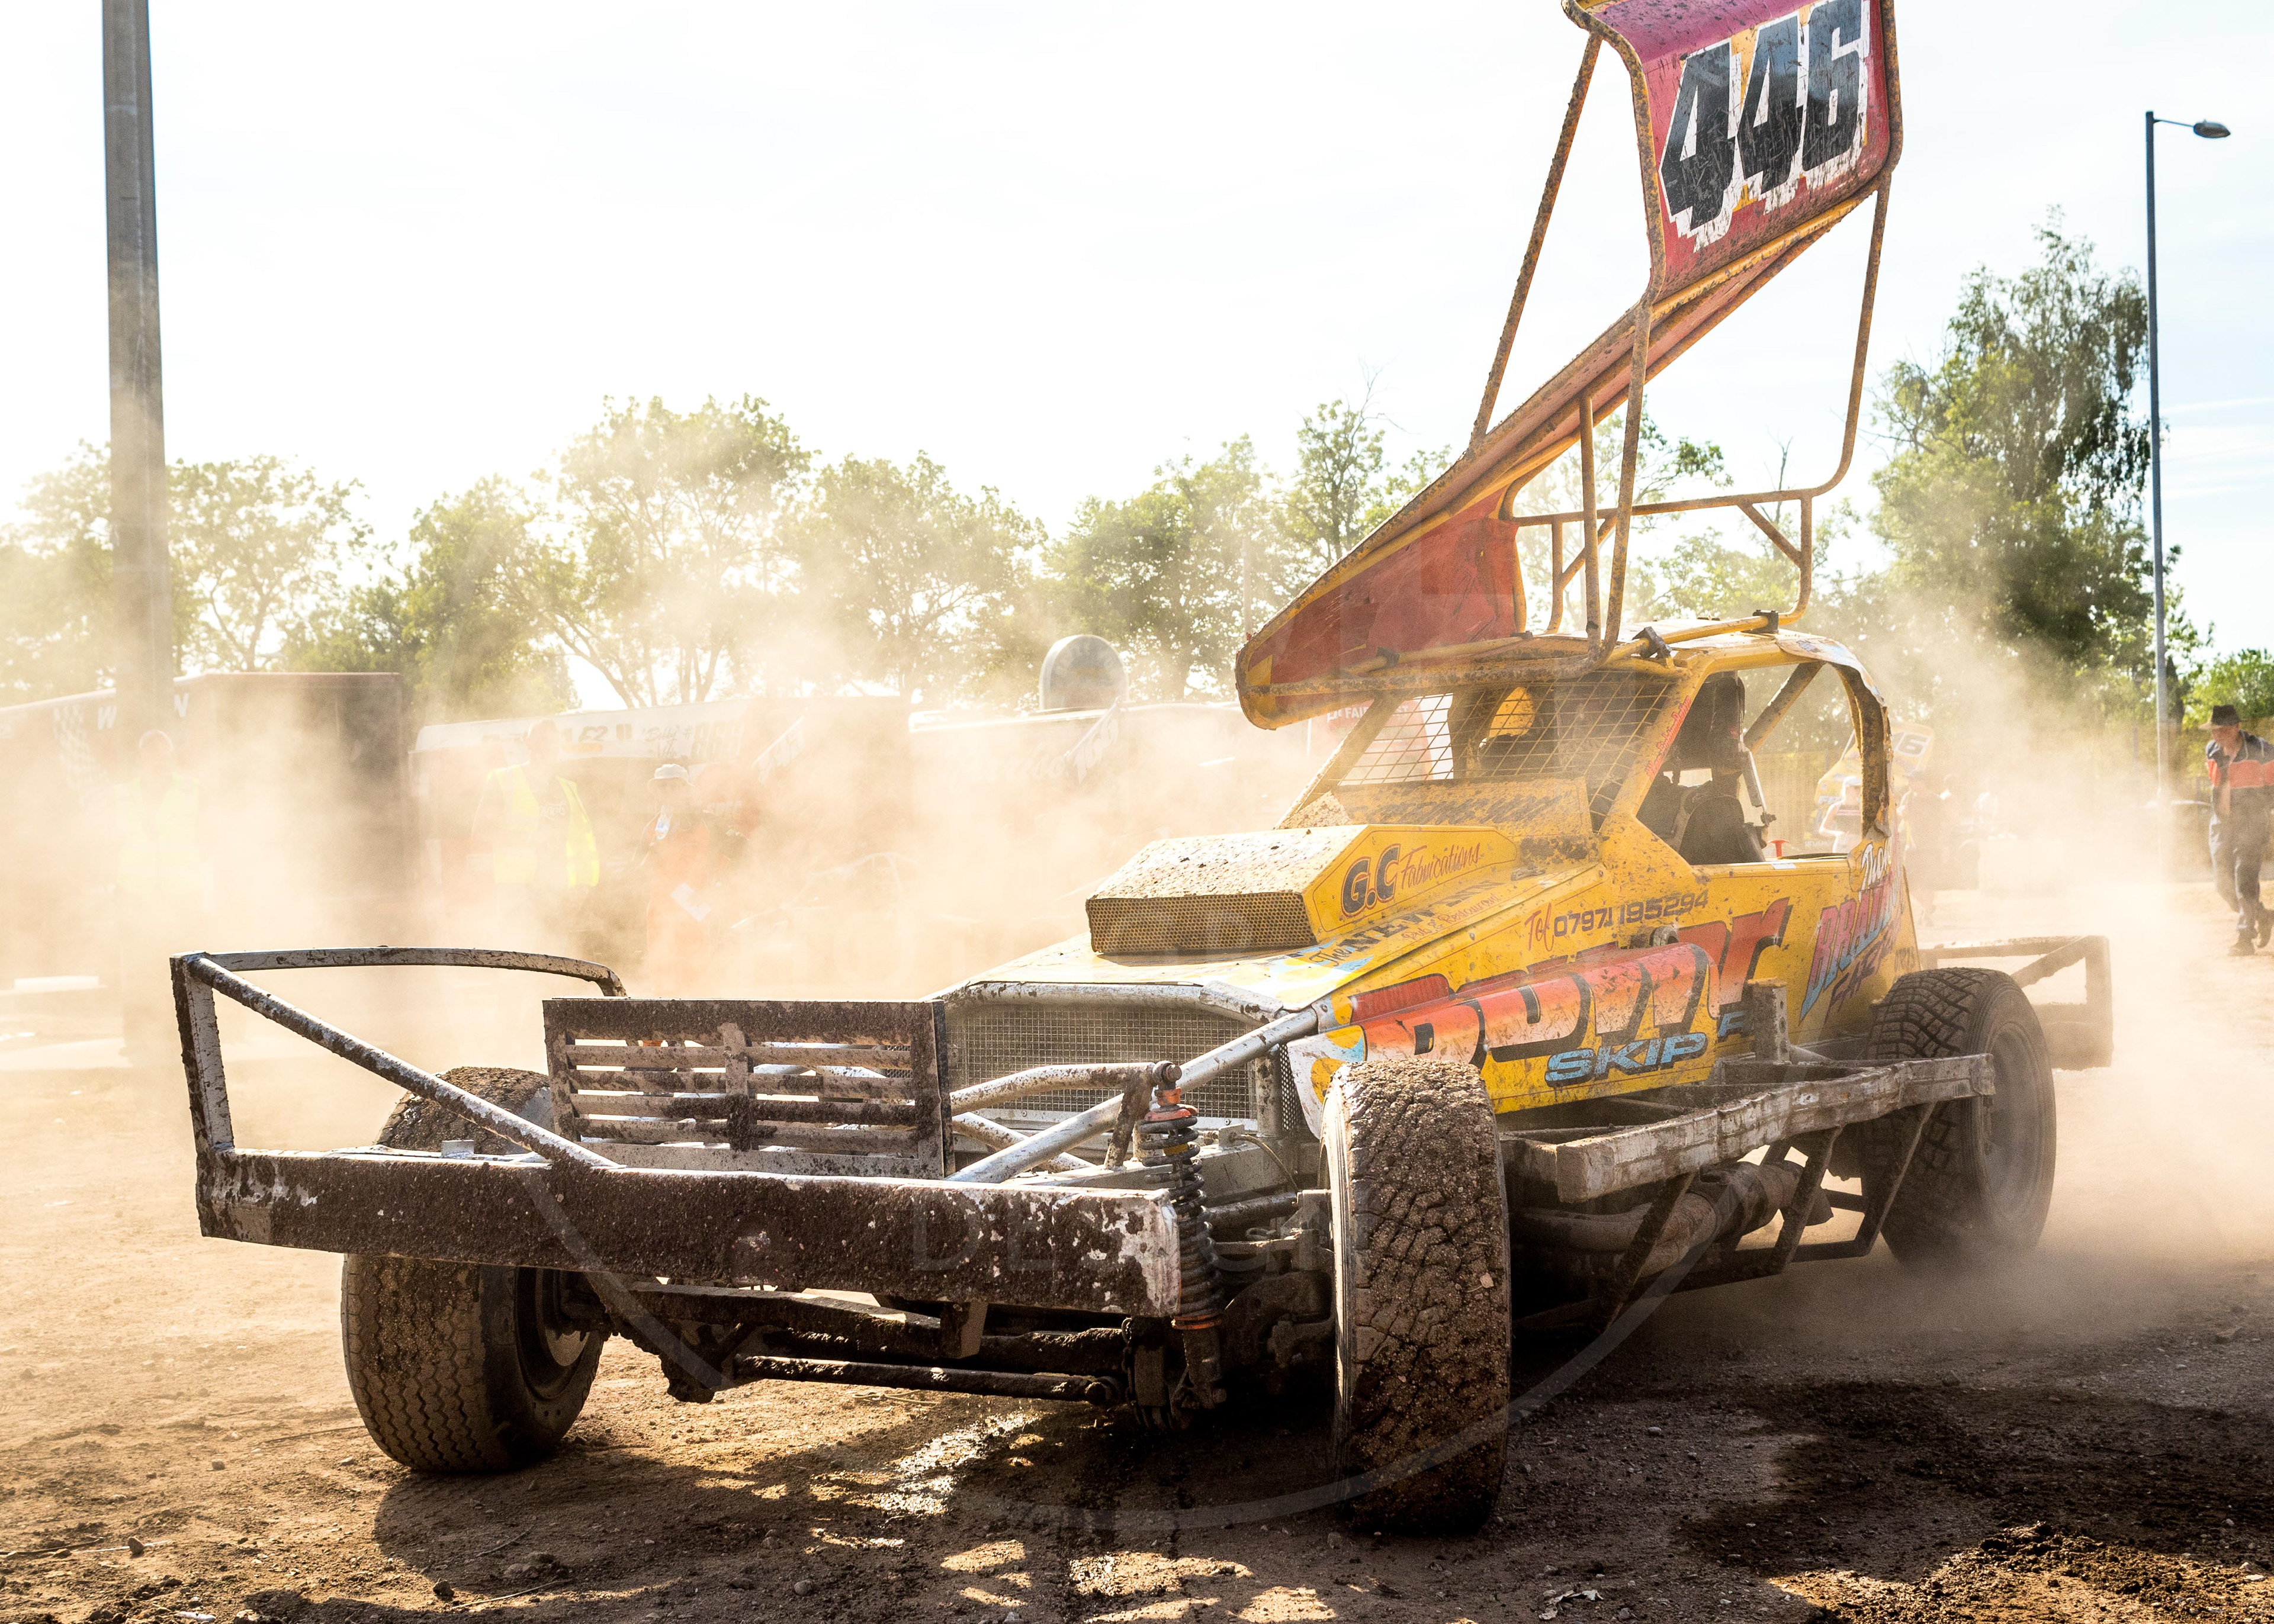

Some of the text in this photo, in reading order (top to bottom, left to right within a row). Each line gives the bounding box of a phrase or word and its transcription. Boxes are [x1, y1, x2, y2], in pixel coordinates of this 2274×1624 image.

[1659, 0, 1870, 232] 446
[1400, 842, 1480, 889] Fabrications
[1524, 889, 1709, 952] Tel 07971 195294
[1309, 946, 1353, 967] The
[1544, 1032, 1708, 1088] SKIP
